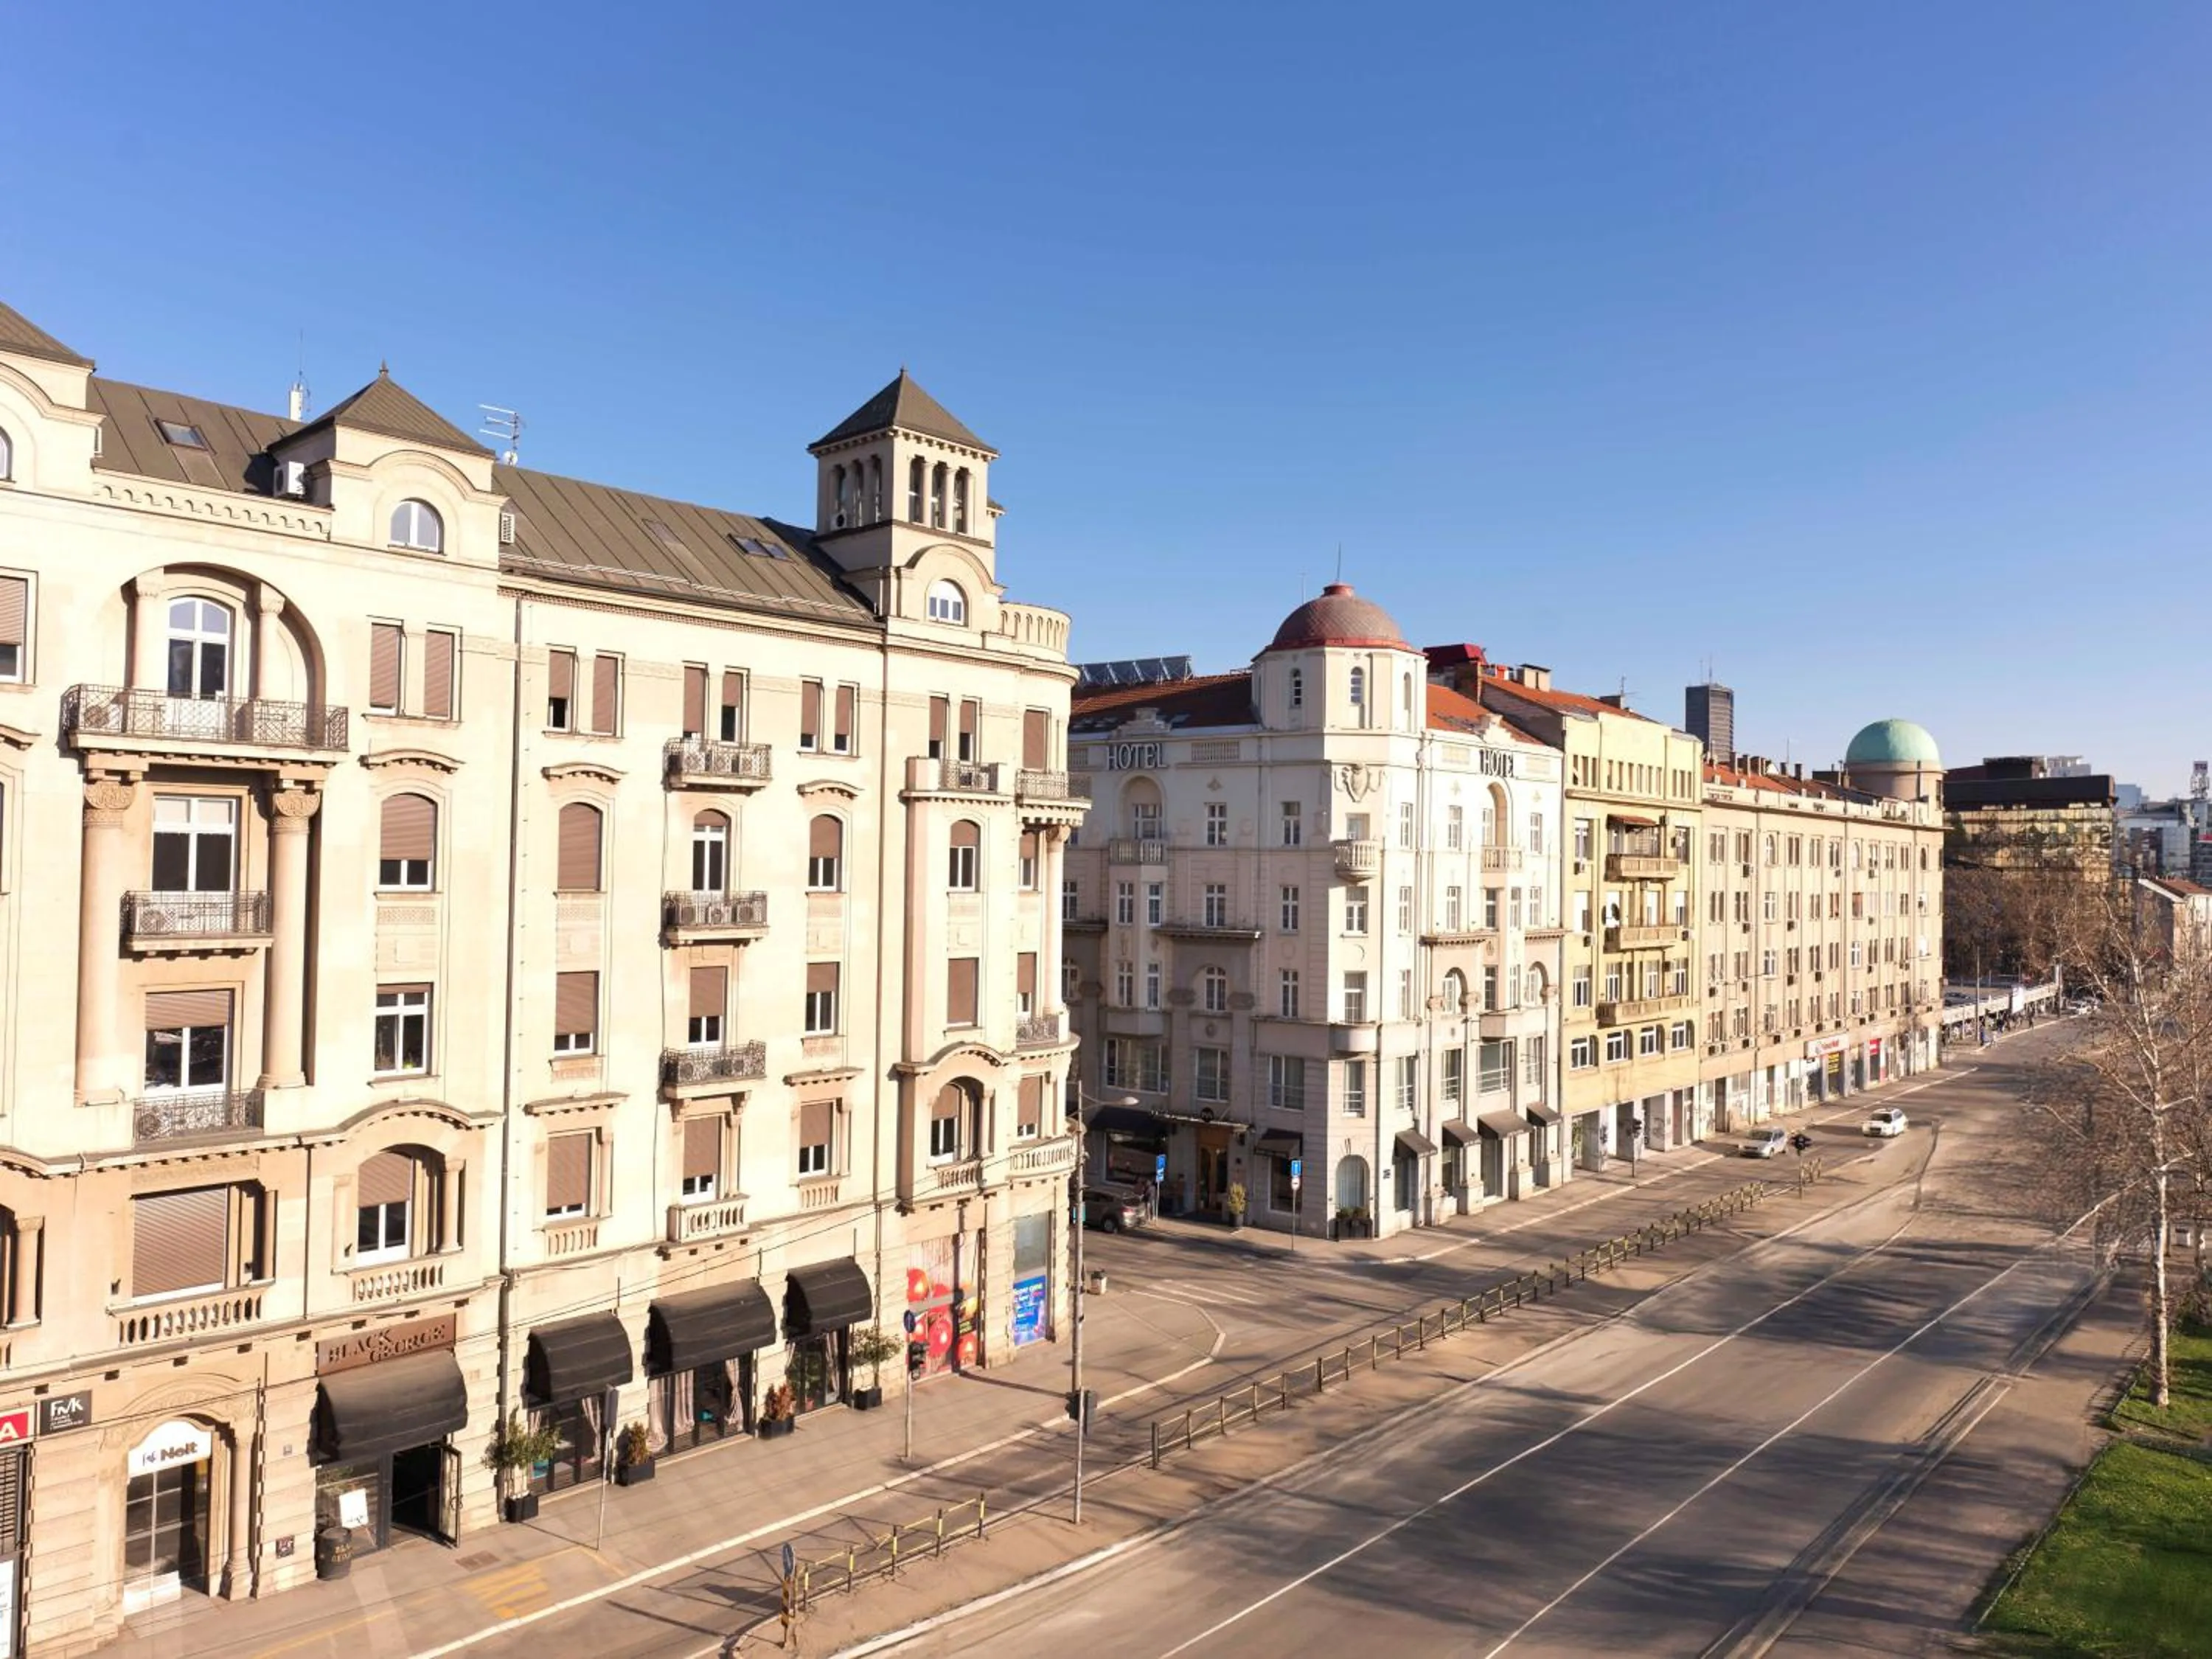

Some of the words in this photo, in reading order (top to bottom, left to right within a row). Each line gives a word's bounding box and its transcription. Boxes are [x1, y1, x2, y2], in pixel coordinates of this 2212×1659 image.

[1106, 742, 1167, 771] HOTEL
[329, 1329, 392, 1363] BLACK
[369, 1325, 445, 1363] GEORGE
